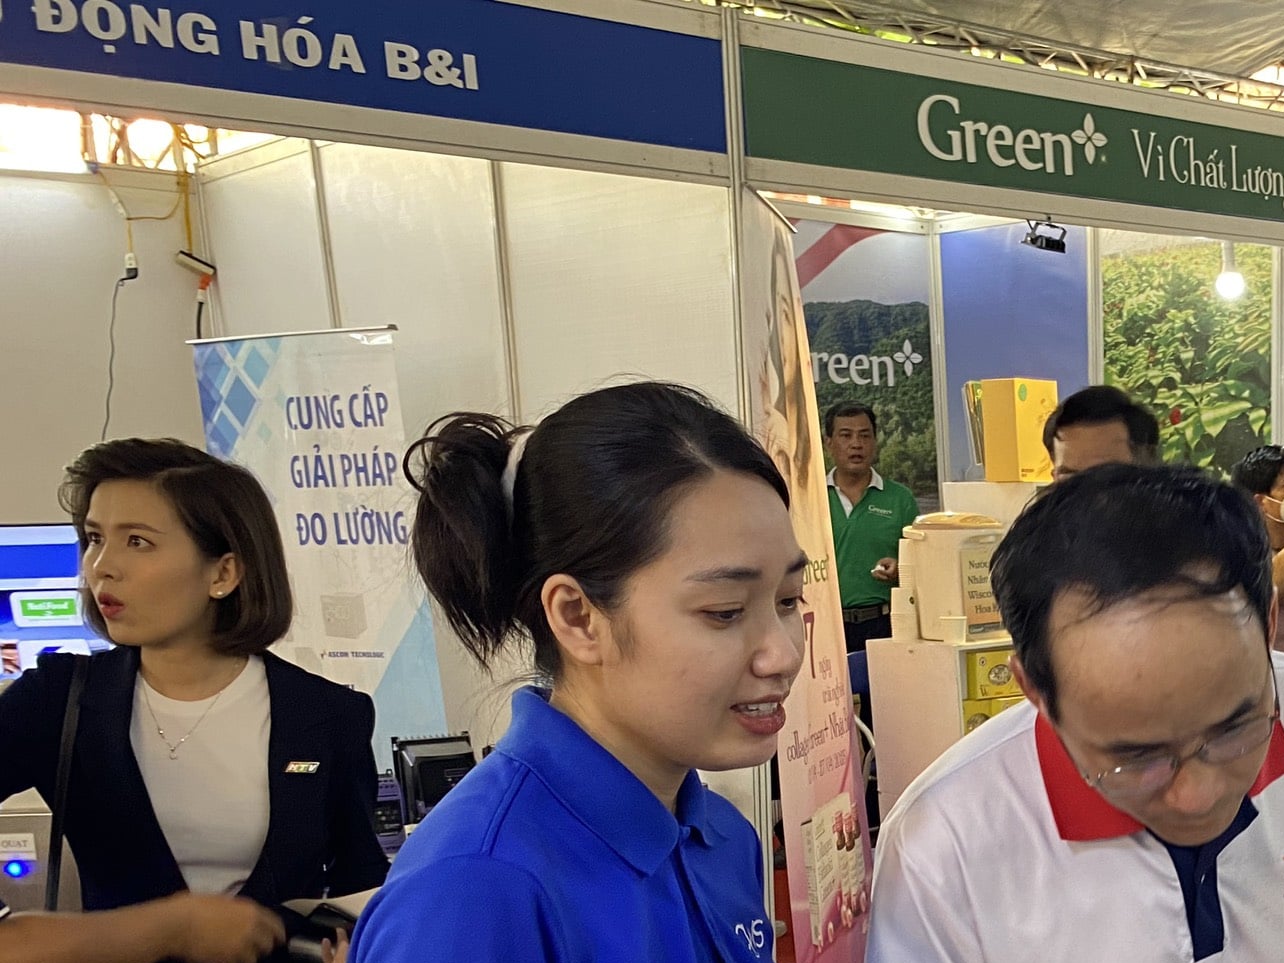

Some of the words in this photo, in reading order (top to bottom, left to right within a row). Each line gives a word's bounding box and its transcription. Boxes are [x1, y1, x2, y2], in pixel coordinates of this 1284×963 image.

[239, 16, 367, 74] HÓA
[384, 41, 479, 91] B&I
[916, 94, 1074, 176] Green
[1131, 128, 1165, 181] Vì
[1169, 135, 1227, 189] Chất
[813, 350, 895, 387] reen
[285, 393, 345, 431] CUNG
[348, 384, 389, 428] CẤP
[290, 444, 337, 489] GIẢI
[344, 445, 398, 488] PHÁP
[296, 511, 328, 546] ĐO
[335, 505, 409, 546] LƯỜNG
[967, 590, 992, 601] Wisco
